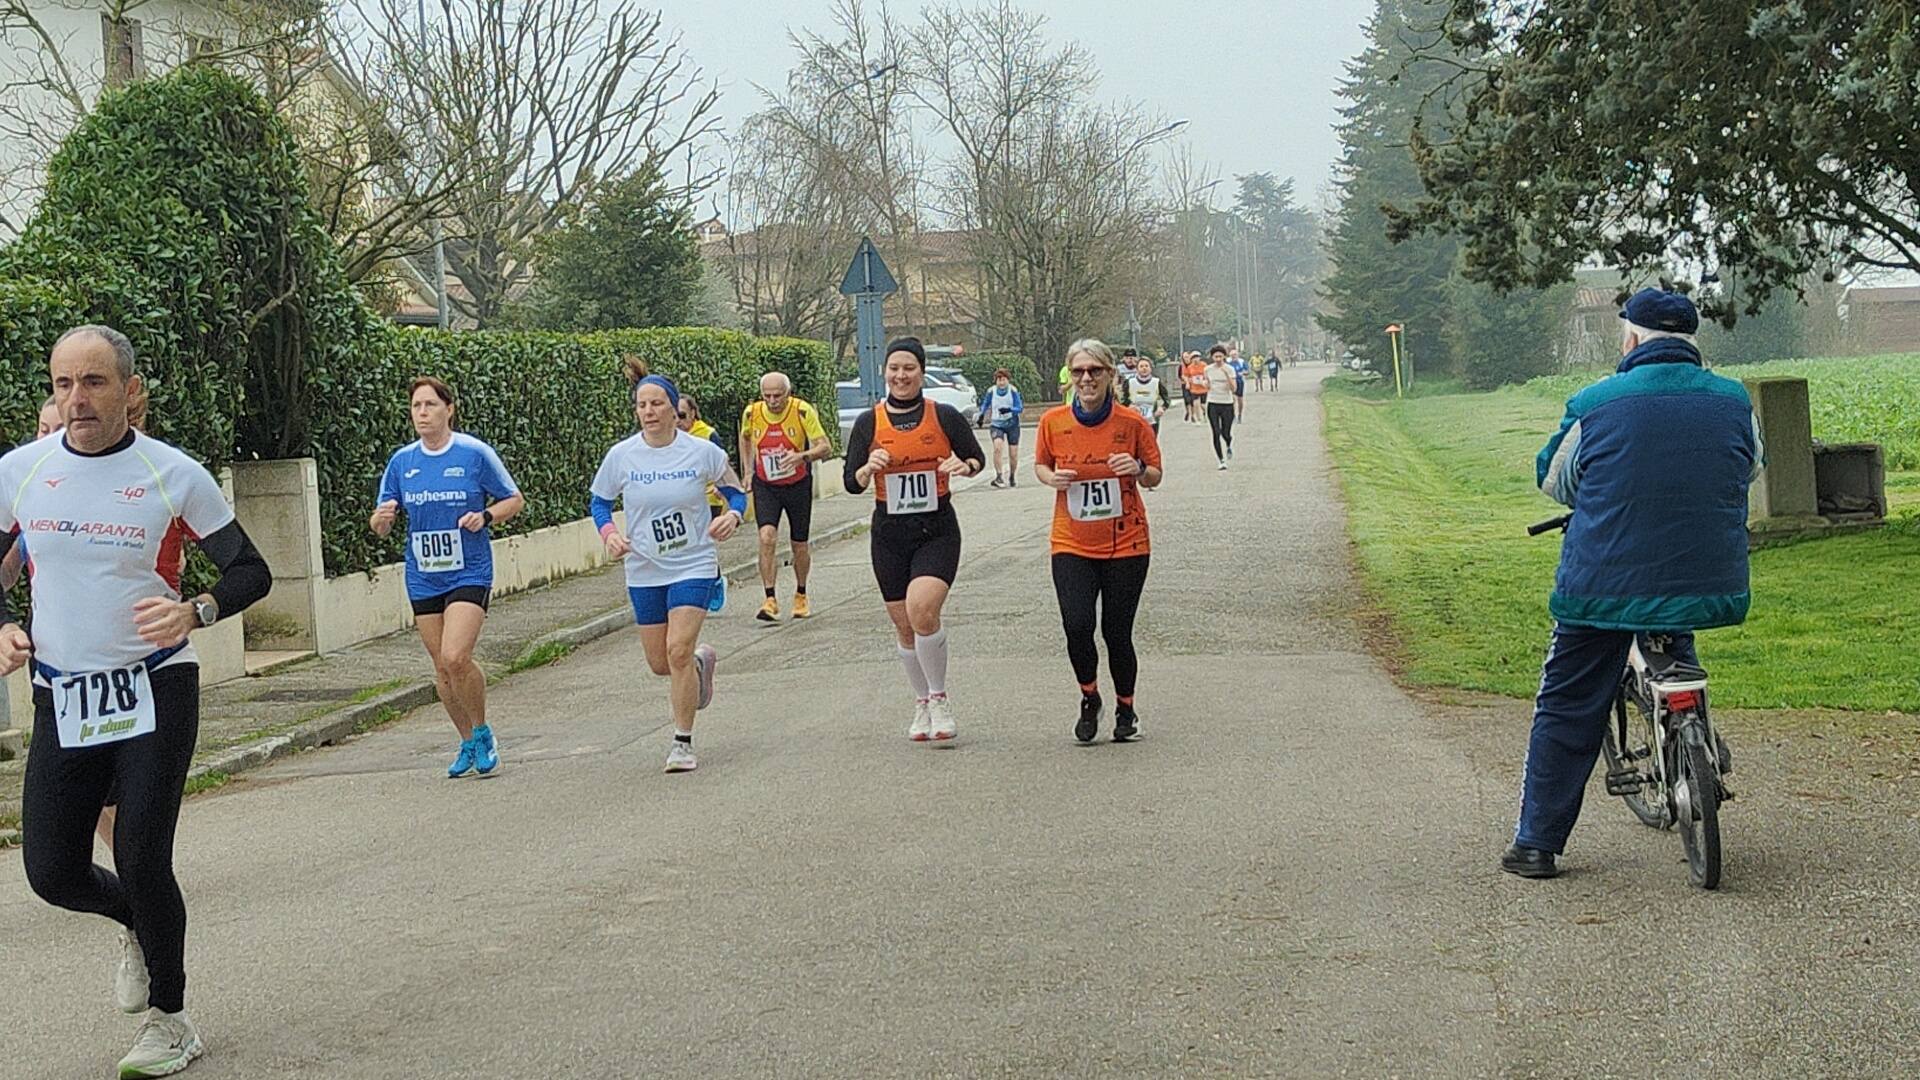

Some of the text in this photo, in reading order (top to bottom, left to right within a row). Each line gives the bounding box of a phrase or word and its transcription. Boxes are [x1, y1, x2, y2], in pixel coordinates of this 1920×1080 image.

[630, 468, 698, 484] lughesina
[898, 474, 928, 499] 710
[405, 490, 467, 506] lughesina
[1080, 480, 1110, 507] 751
[651, 511, 687, 543] 653
[421, 532, 453, 558] 609
[65, 668, 137, 720] 728
